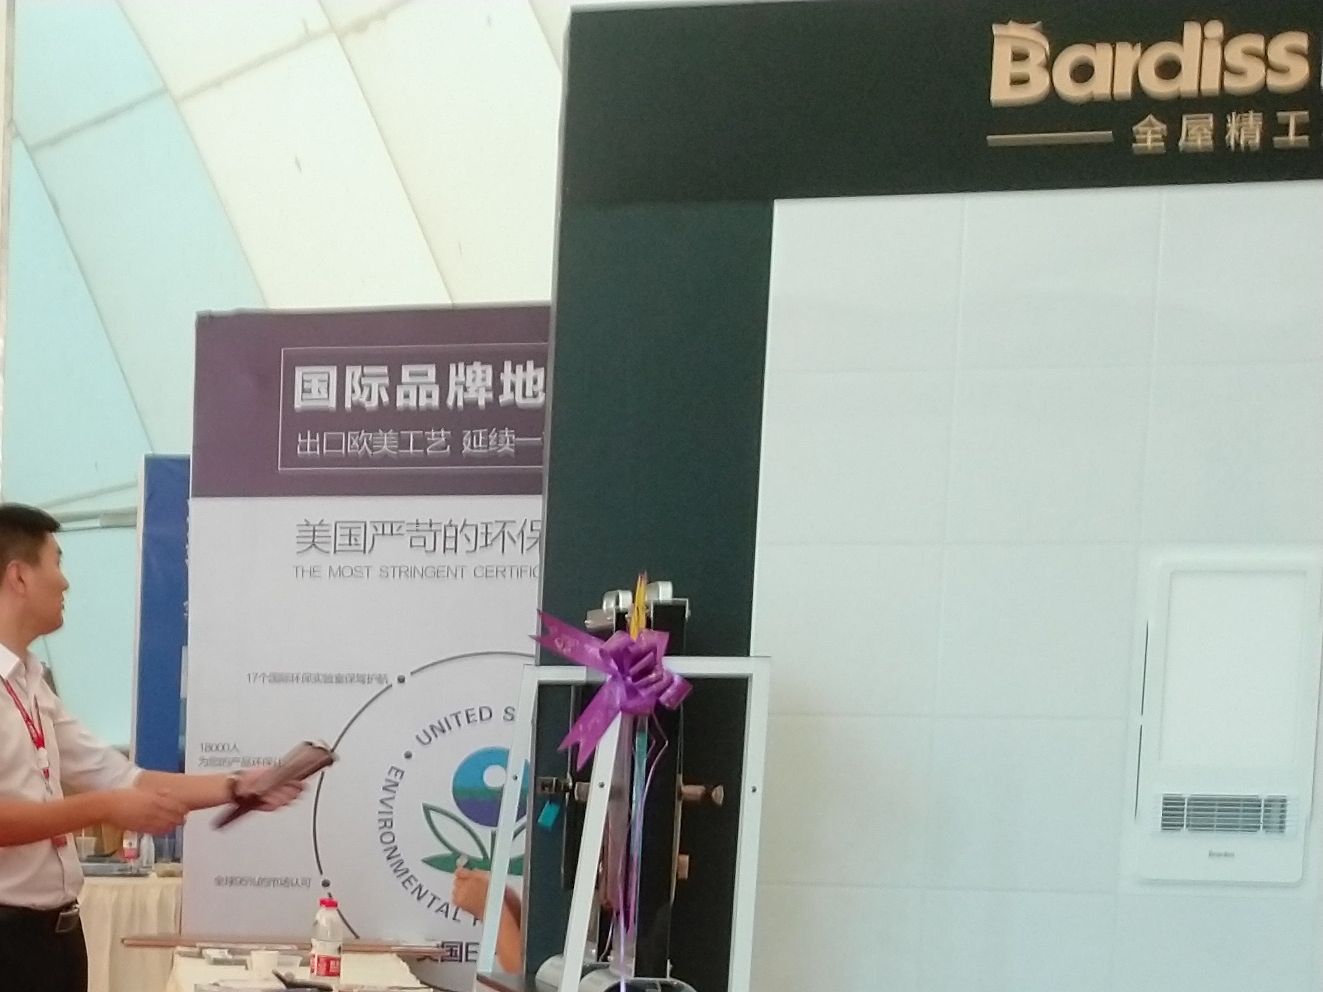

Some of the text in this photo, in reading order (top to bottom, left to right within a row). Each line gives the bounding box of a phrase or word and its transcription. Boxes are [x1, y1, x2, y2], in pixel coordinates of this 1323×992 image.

[990, 19, 1309, 108] Bardiss
[1132, 110, 1310, 155] 全屋精工
[294, 360, 545, 411] 国际品牌地
[297, 428, 451, 457] 出口欧美工艺
[295, 518, 541, 554] 美国严苛的环保
[293, 565, 322, 579] THE
[328, 565, 372, 579] MOST
[379, 565, 468, 579] STRINGENT
[415, 705, 493, 747] UNITED
[378, 765, 461, 923] ENVIRONMENTAL
